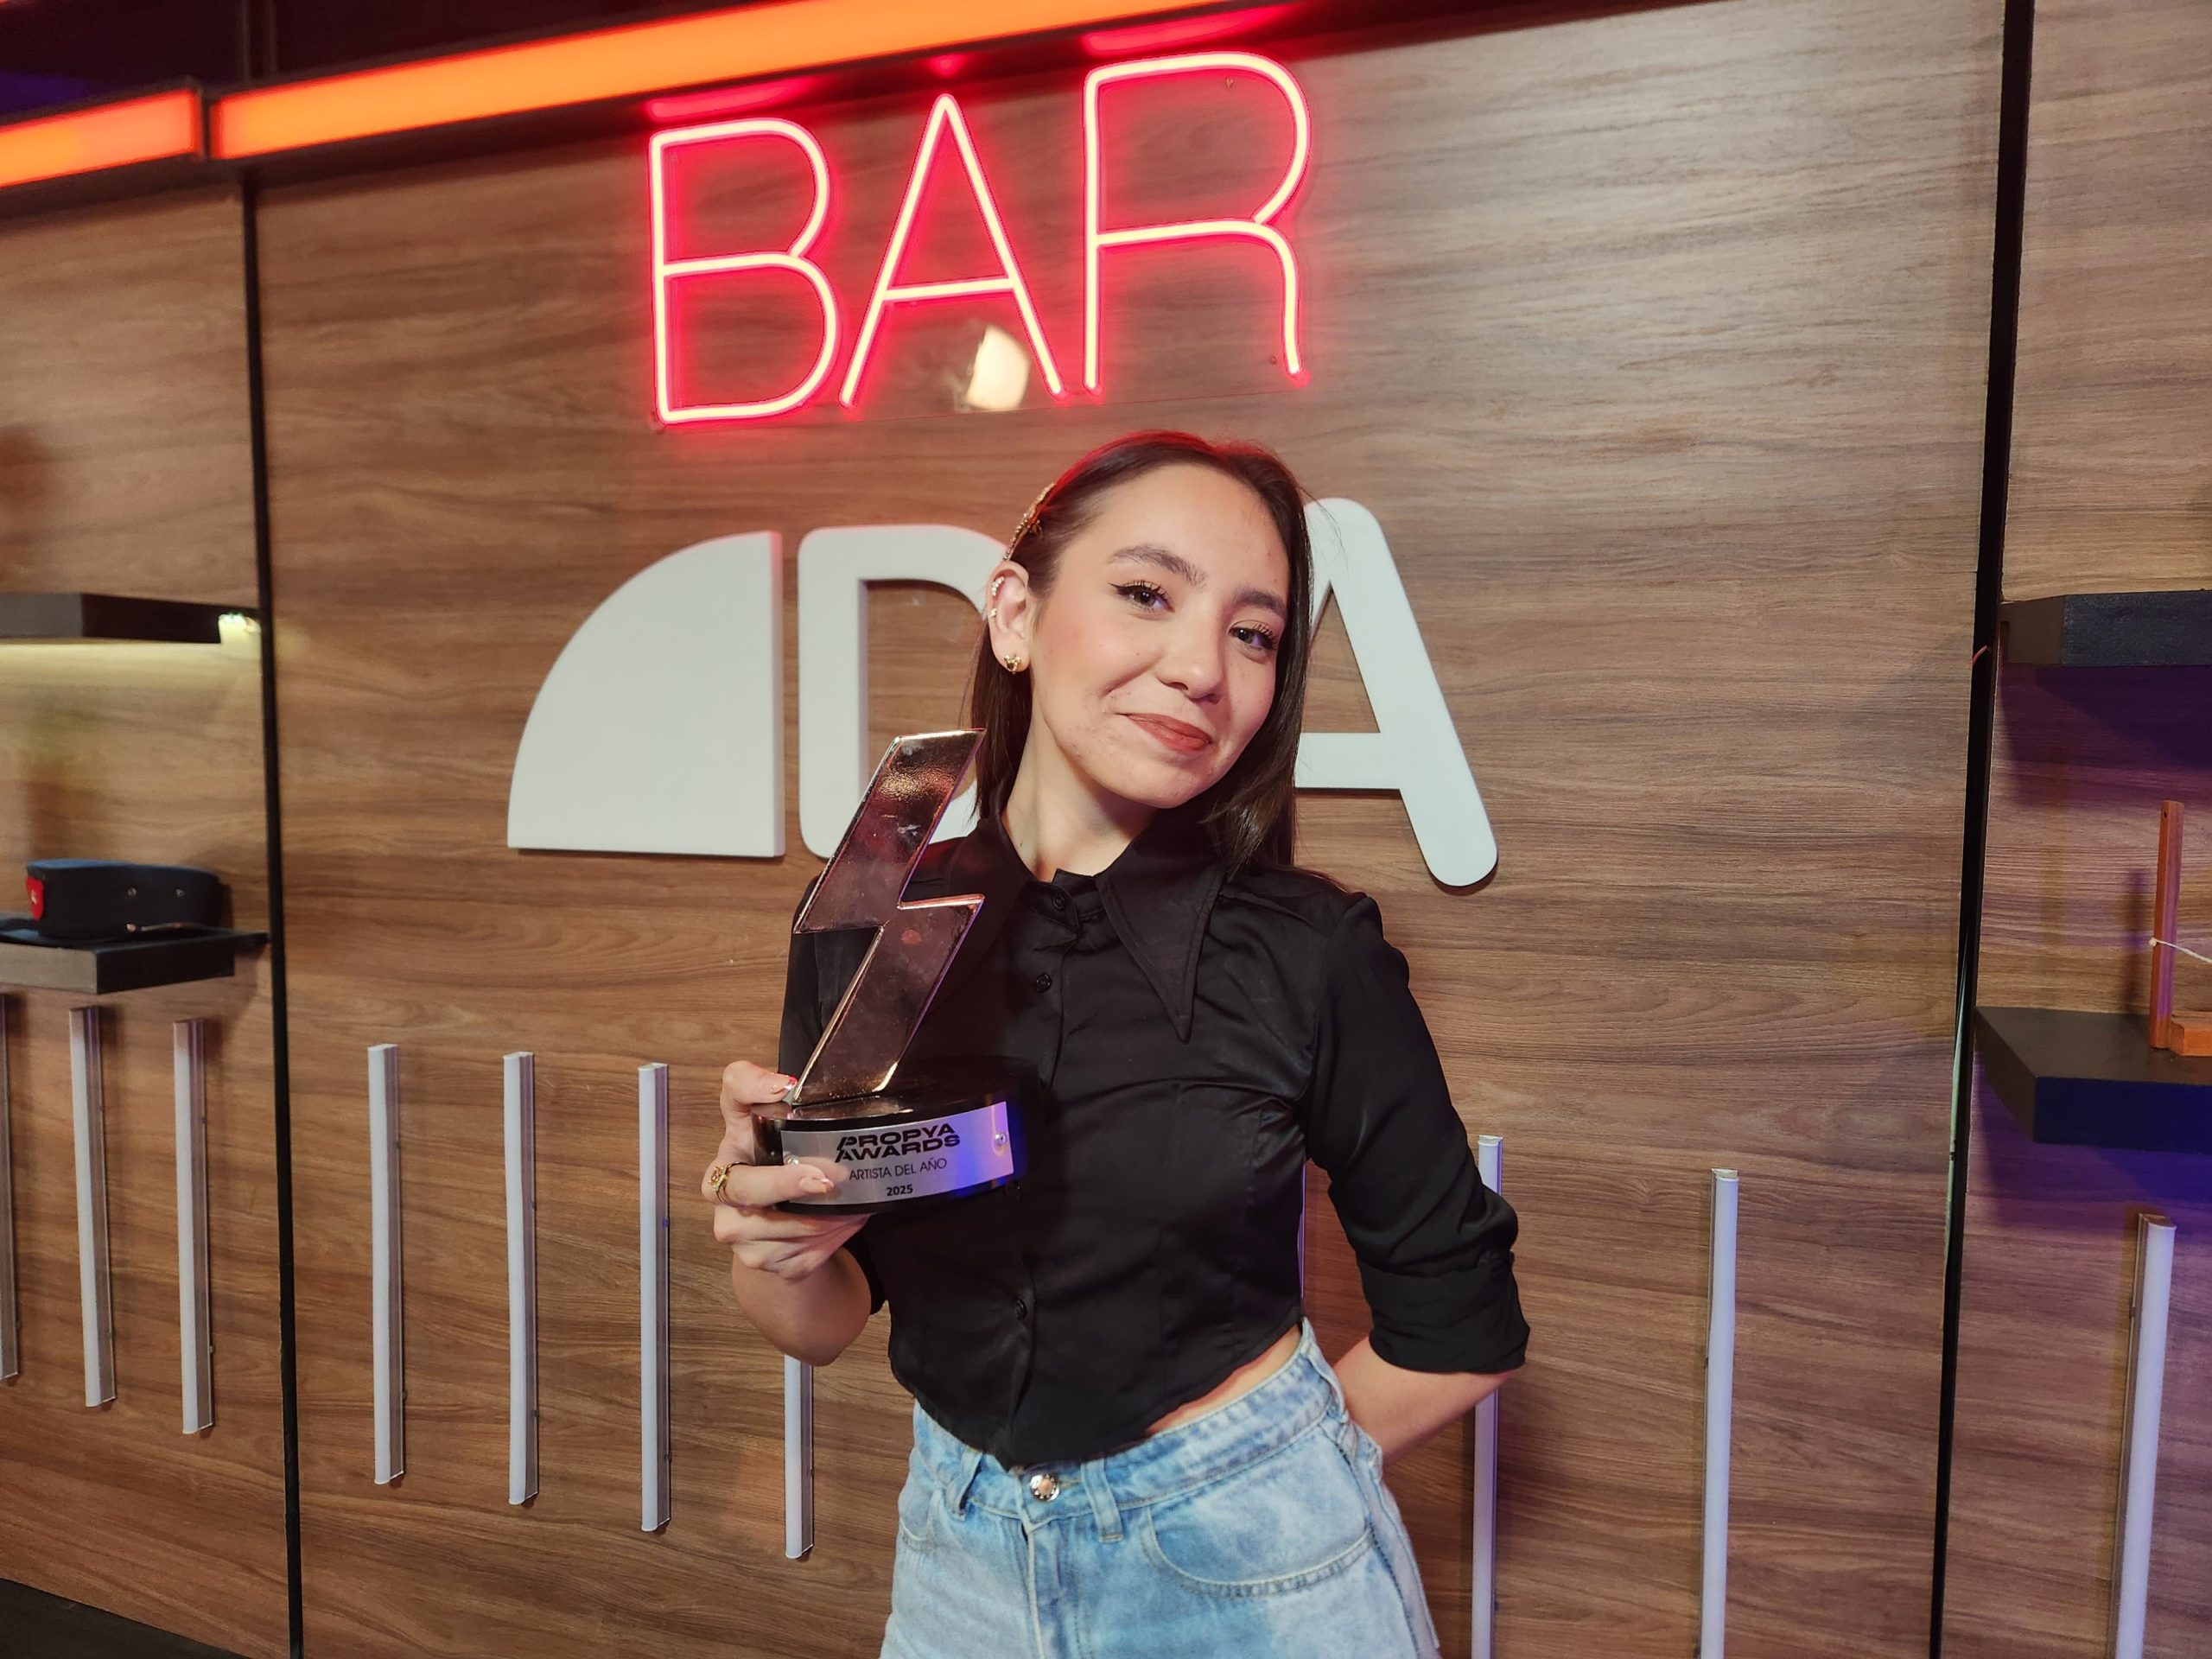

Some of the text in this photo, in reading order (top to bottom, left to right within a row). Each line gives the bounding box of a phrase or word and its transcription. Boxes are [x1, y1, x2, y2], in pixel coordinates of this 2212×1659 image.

[649, 52, 1312, 425] BAR
[835, 1135, 960, 1163] AWARDS
[836, 1123, 955, 1151] PROPYA
[849, 1157, 947, 1180] ARTISTA DEL AÑO
[886, 1184, 913, 1197] 2025
